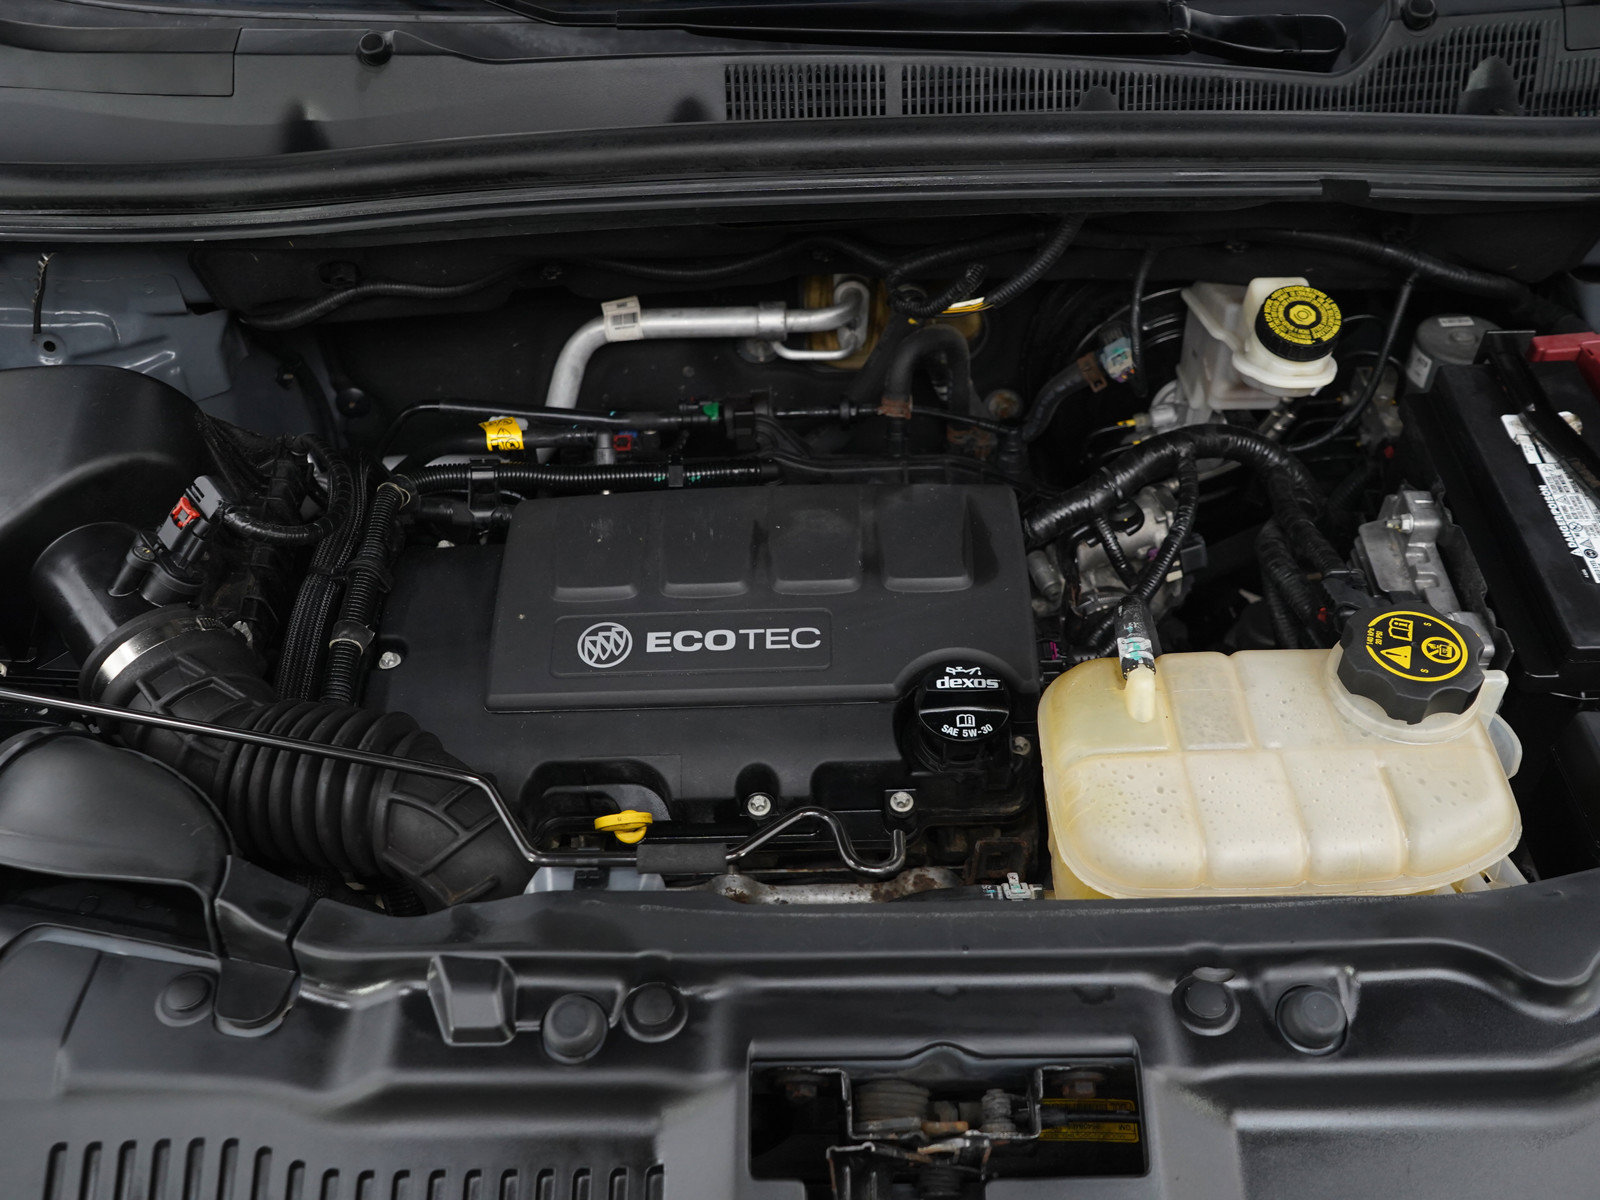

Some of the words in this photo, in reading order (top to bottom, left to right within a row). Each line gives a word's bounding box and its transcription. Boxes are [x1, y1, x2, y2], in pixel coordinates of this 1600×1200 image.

[1538, 484, 1579, 549] DANGER/POISON
[646, 627, 821, 653] ECOTEC
[936, 676, 1001, 689] dexos
[941, 724, 959, 737] SAE
[962, 723, 993, 738] 5W-30
